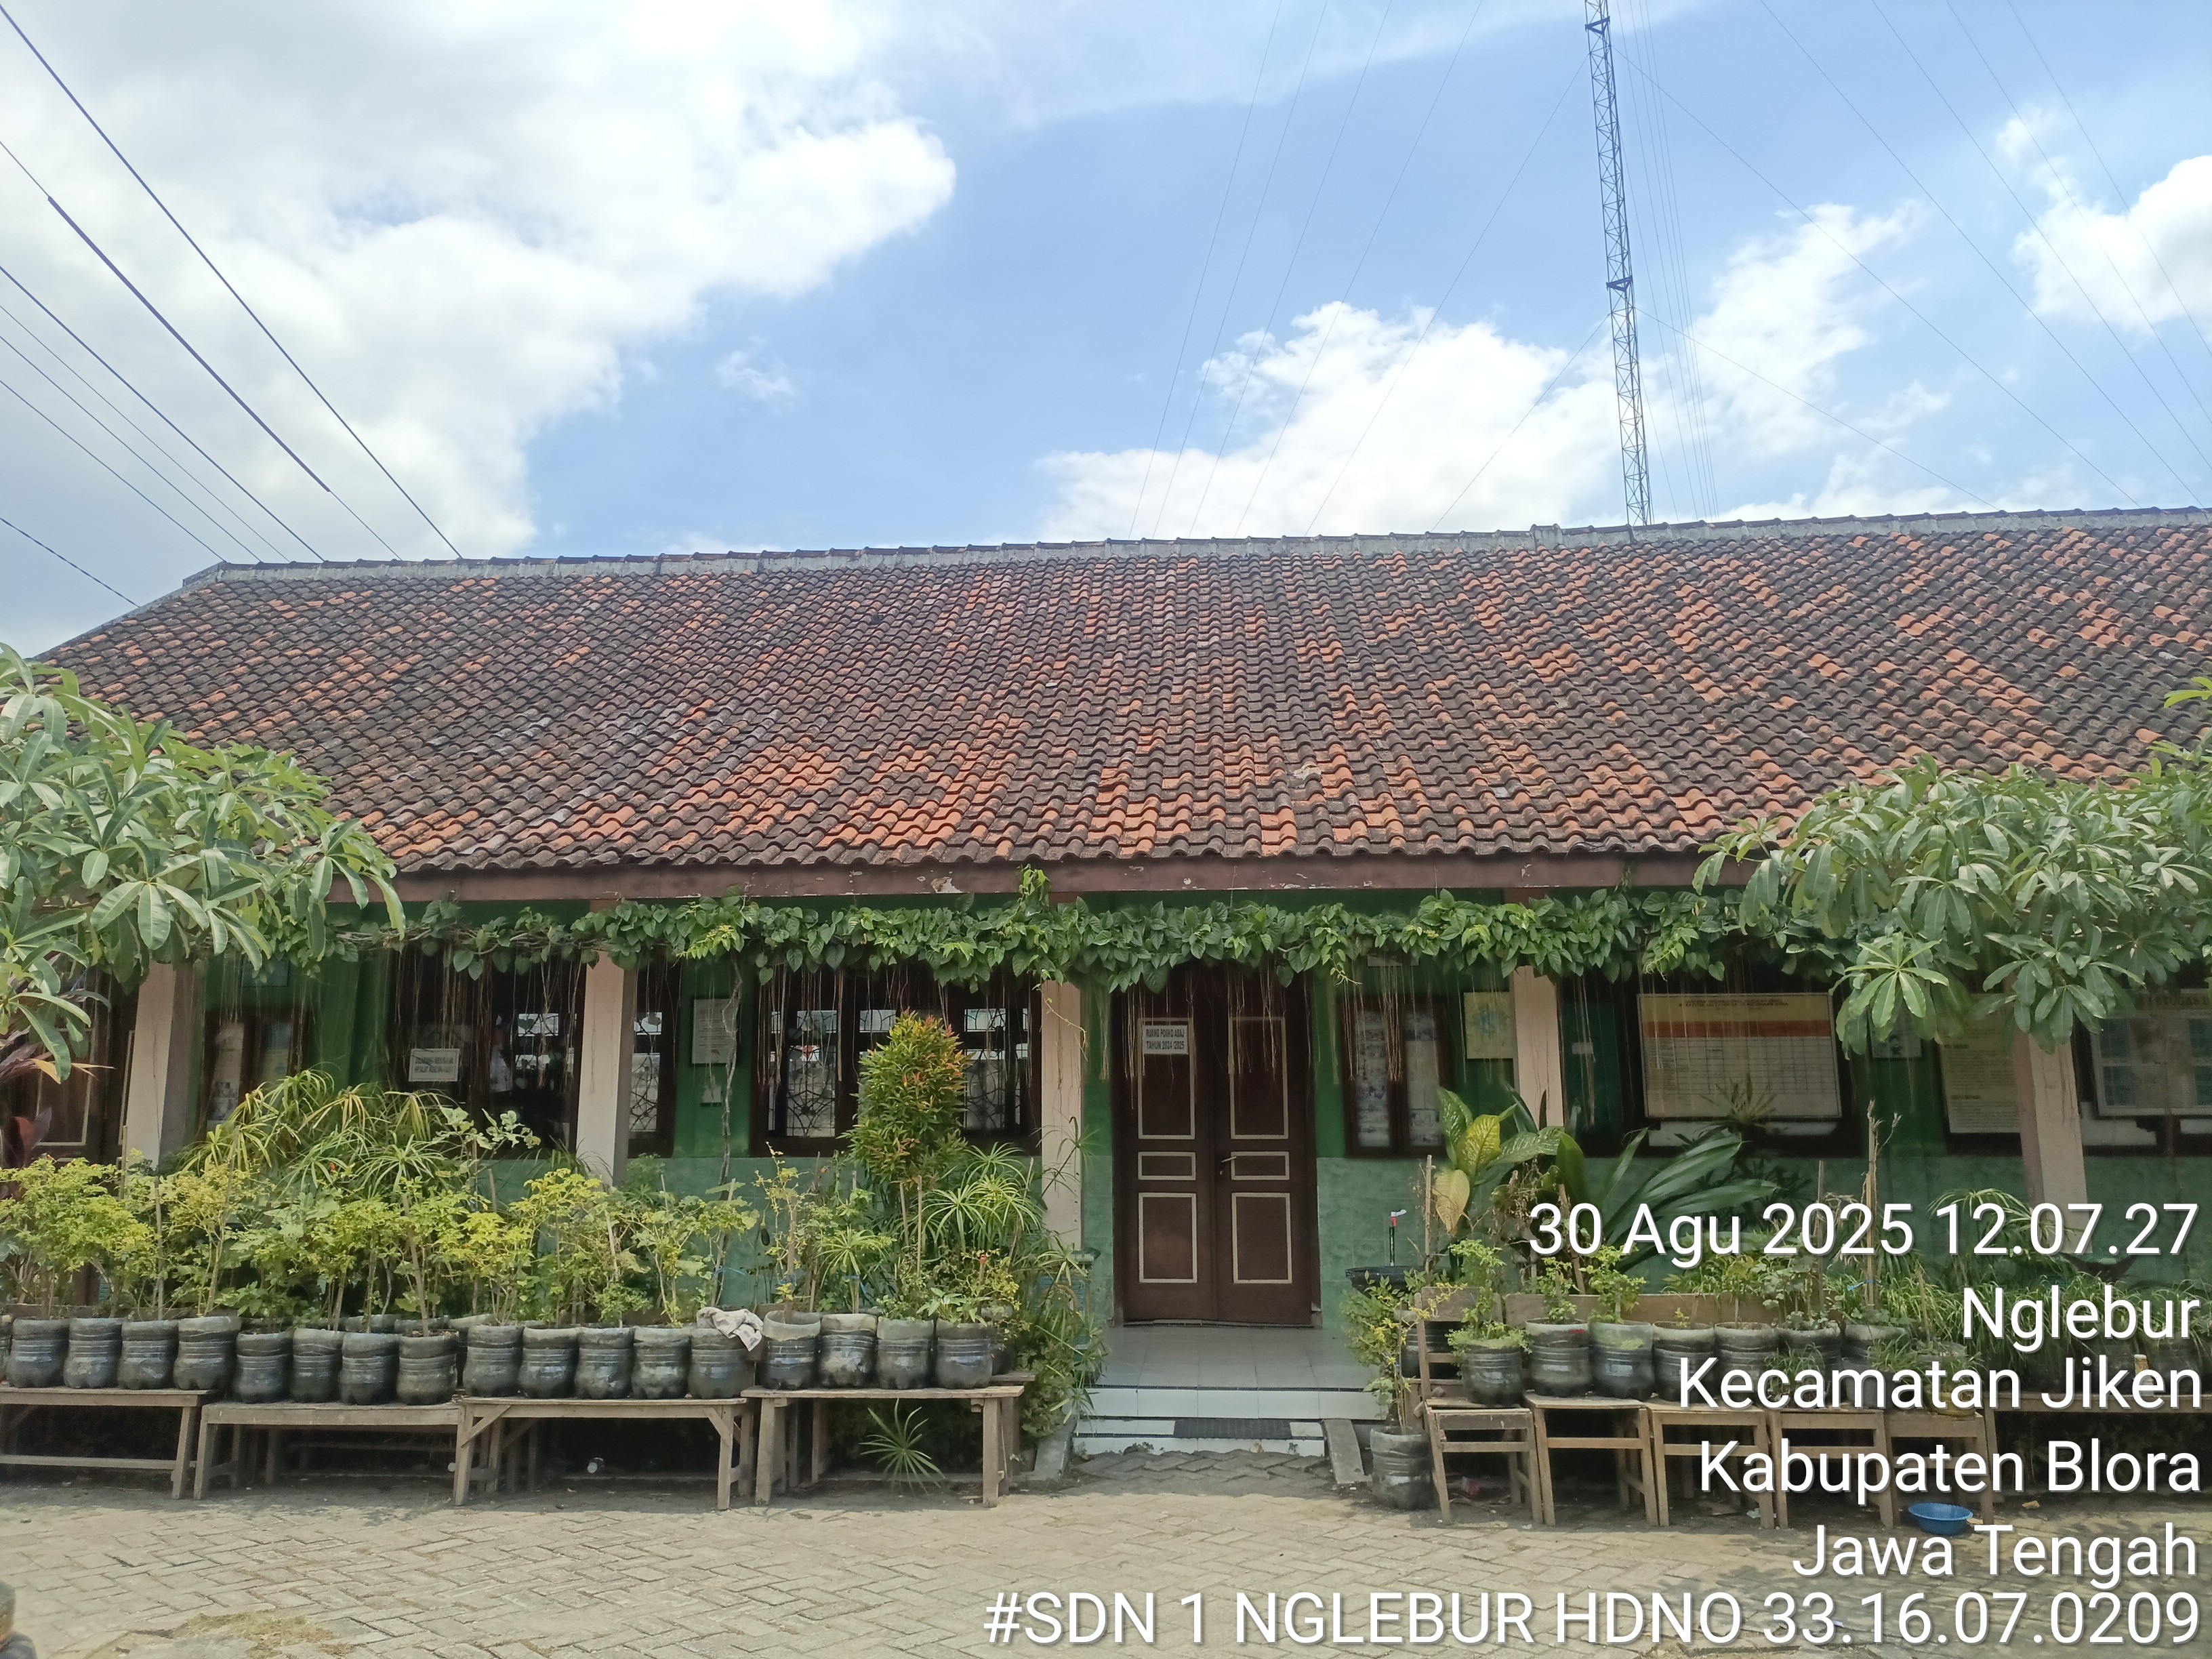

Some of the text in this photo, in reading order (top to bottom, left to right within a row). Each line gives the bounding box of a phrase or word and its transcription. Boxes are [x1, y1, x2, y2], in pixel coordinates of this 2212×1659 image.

[1146, 1029, 1160, 1038] RUANG
[1160, 1029, 1174, 1038] POSKO
[1146, 1040, 1162, 1050] TAHUN
